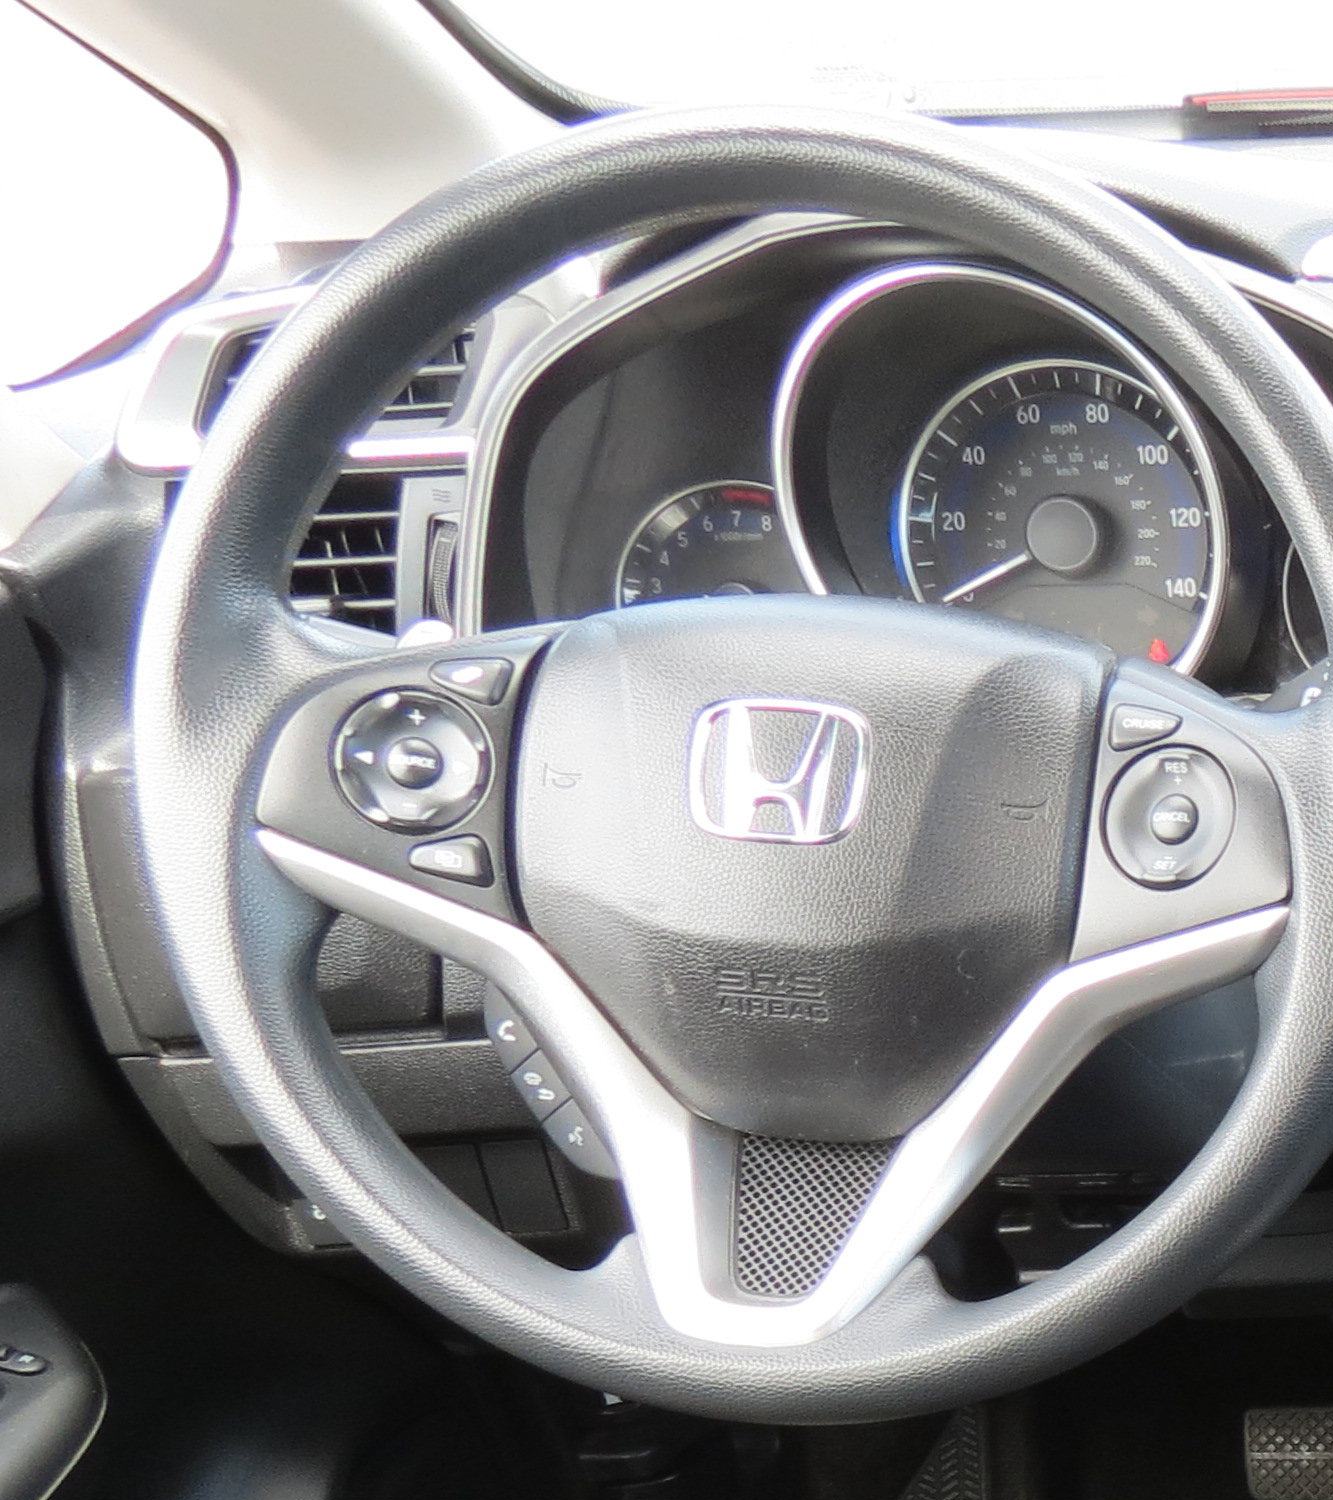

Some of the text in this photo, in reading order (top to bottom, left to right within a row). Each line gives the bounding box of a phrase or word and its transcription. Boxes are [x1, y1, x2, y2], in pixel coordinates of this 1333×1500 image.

[1016, 404, 1040, 425] 60
[1085, 403, 1110, 424] 80
[1049, 422, 1078, 436] mph
[961, 446, 986, 466] 40
[1136, 444, 1169, 465] 100
[702, 515, 714, 532] 6
[731, 510, 742, 528] 7
[761, 515, 773, 532] 8
[941, 511, 967, 532] 20
[1168, 506, 1202, 528] 120
[677, 531, 689, 548] 5
[659, 551, 670, 567] 4
[650, 577, 662, 594] 3
[1165, 577, 1197, 598] 140
[1164, 761, 1189, 774] RES
[1153, 860, 1177, 870] SET
[716, 968, 826, 999] SRS
